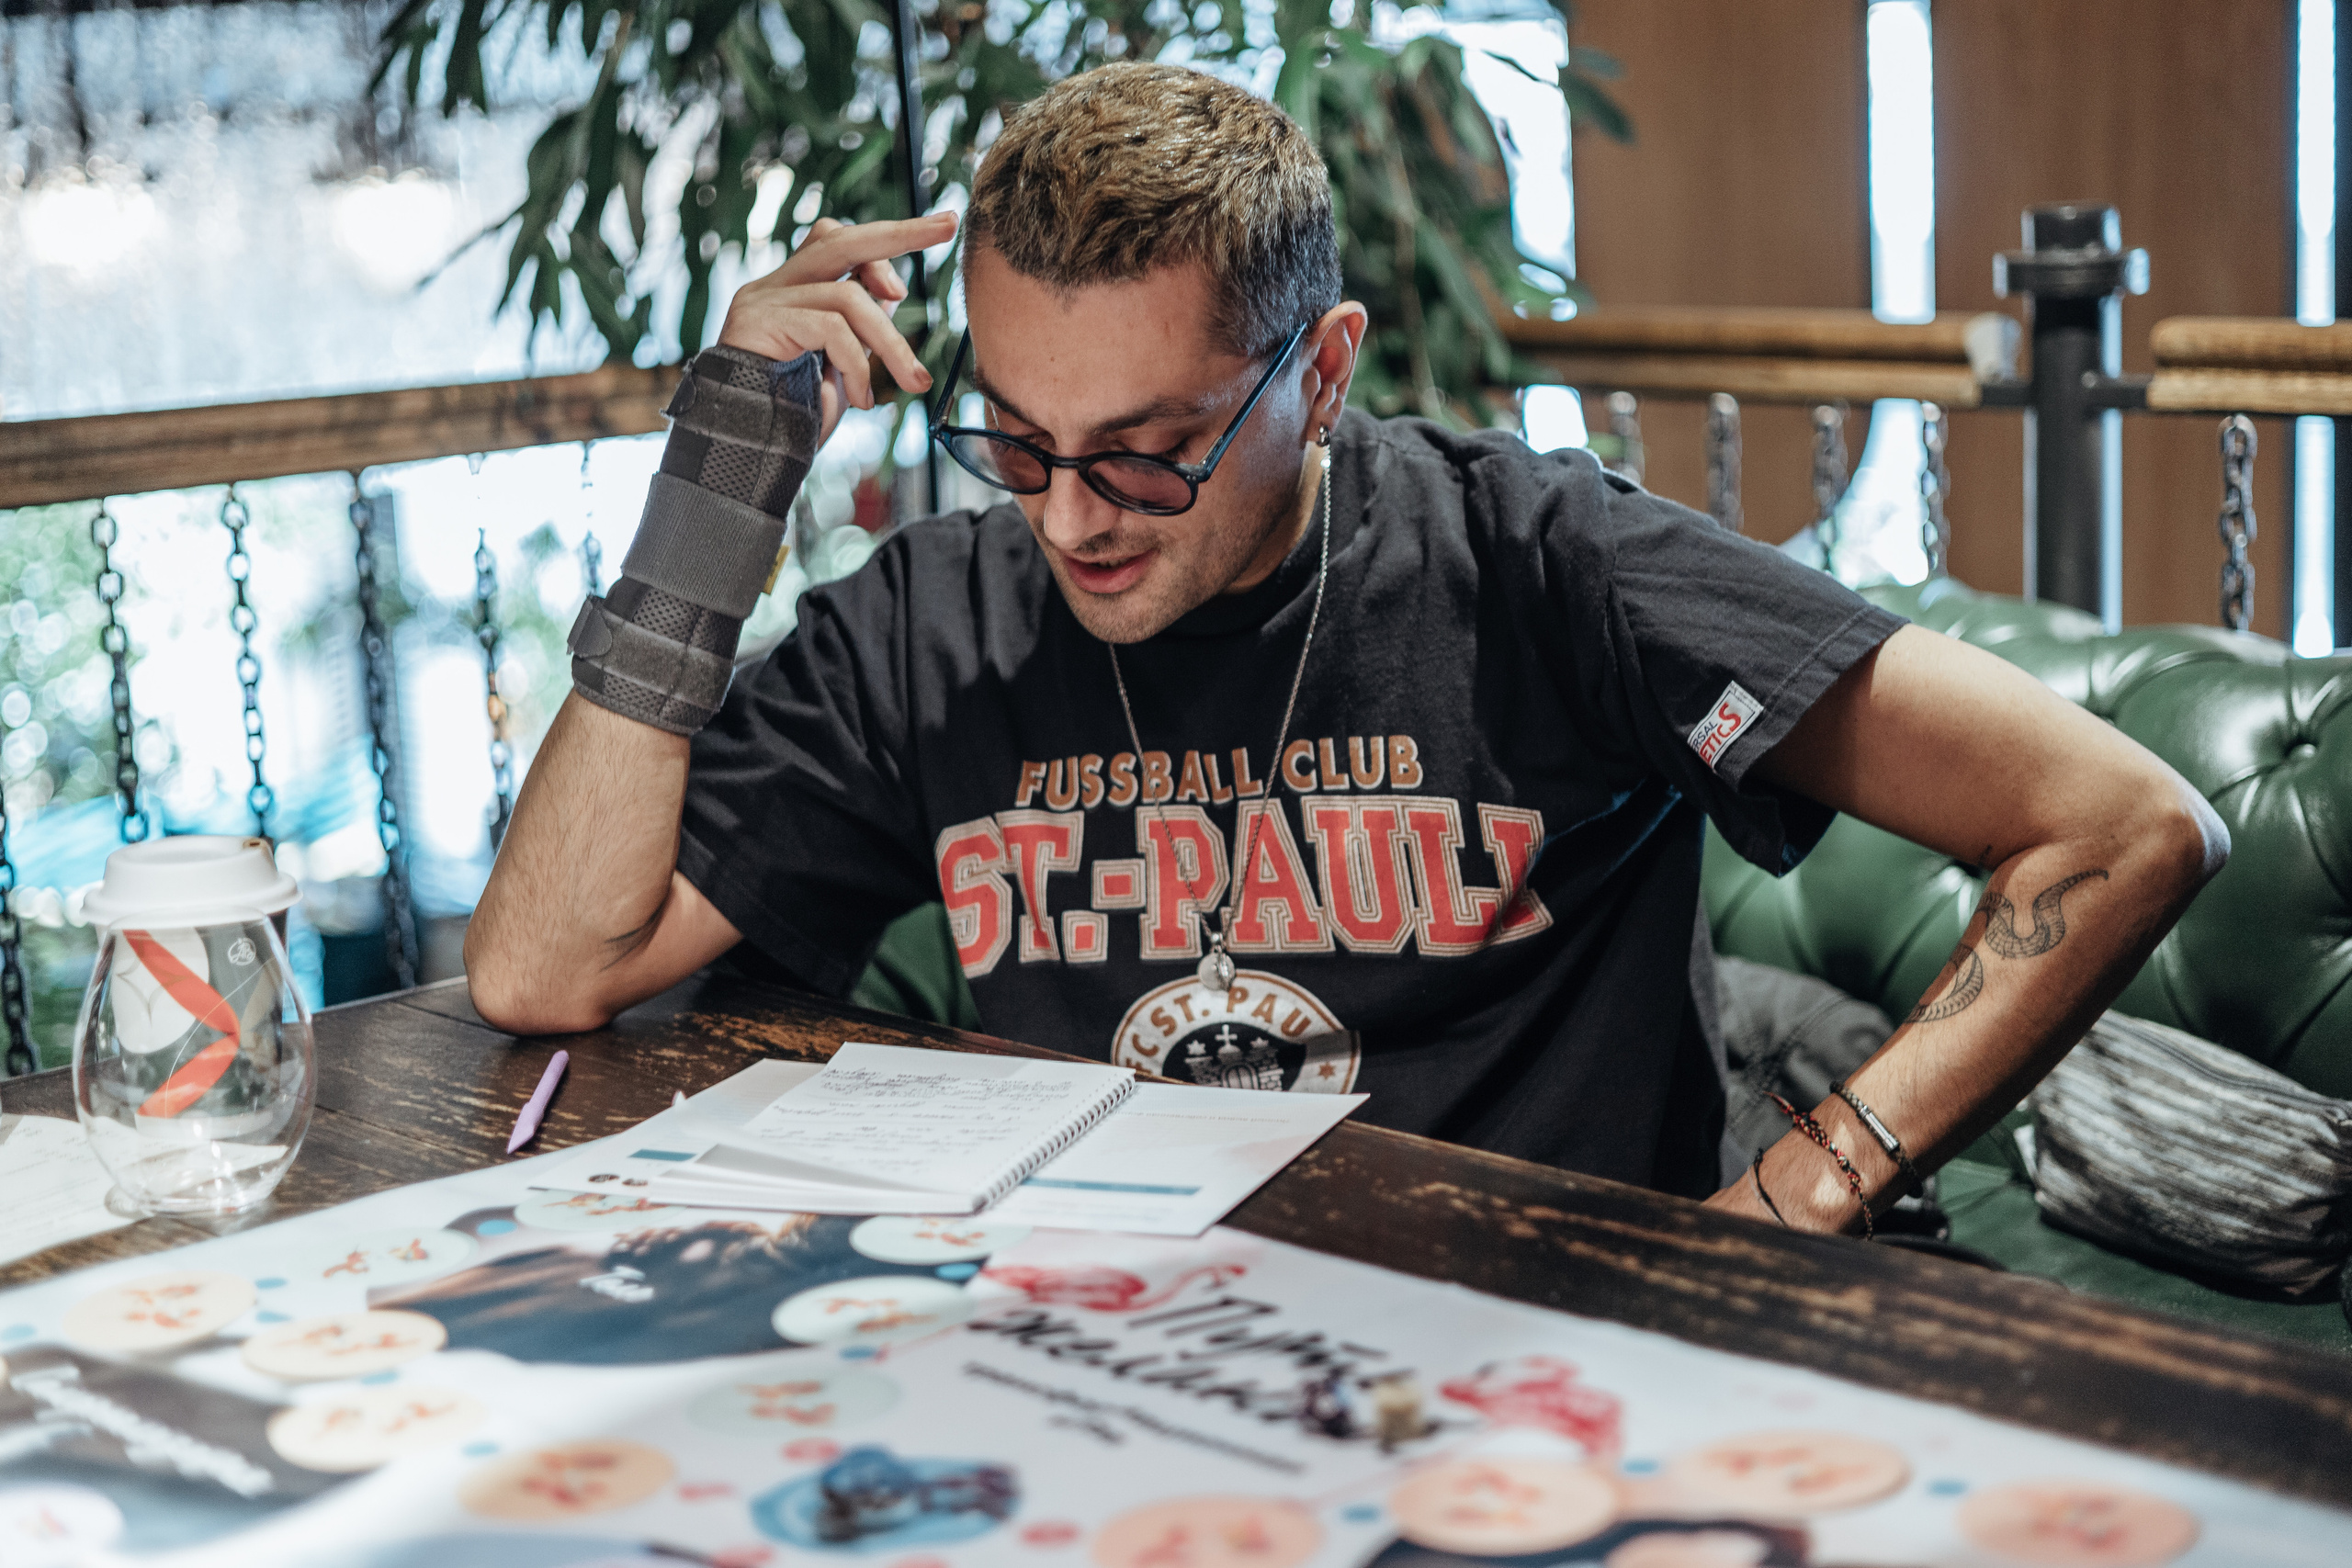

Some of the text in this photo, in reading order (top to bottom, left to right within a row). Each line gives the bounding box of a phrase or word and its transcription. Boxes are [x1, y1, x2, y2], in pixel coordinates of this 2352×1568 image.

[1014, 734, 1424, 811] FUSSBALL CLUB
[1150, 993, 1210, 1038] ST.
[1226, 986, 1313, 1038] PAU
